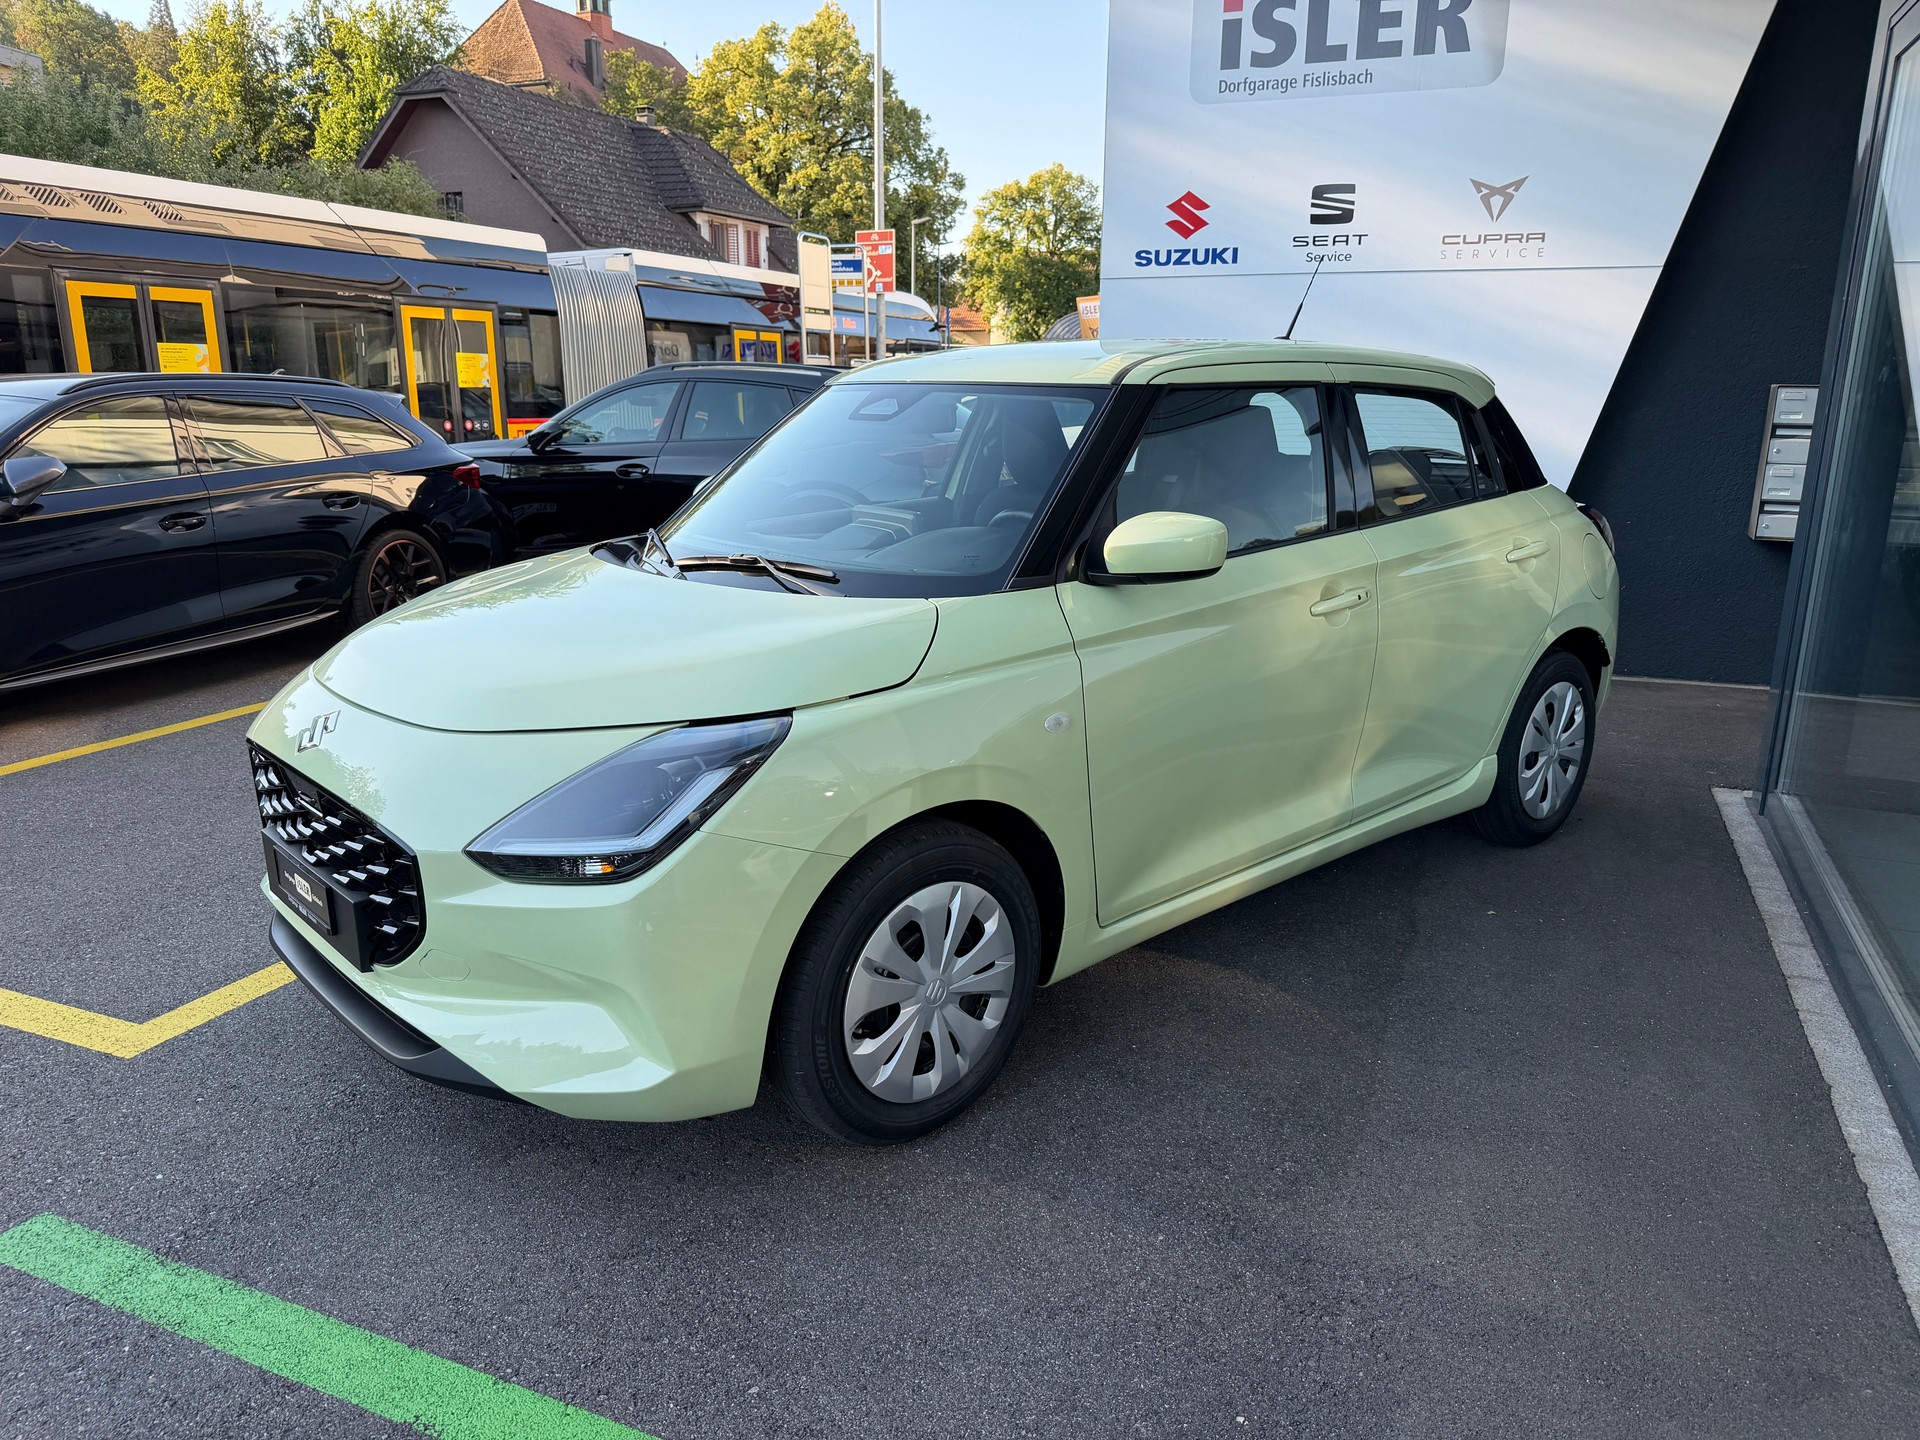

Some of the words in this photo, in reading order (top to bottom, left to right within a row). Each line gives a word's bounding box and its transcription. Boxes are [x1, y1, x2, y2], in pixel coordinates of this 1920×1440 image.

[1218, 76, 1298, 96] Dorfgarage
[1303, 68, 1374, 88] Fislisbach
[1292, 233, 1369, 248] SEAT
[1441, 232, 1546, 246] CUPRA
[1134, 247, 1239, 268] SUZUKI
[1305, 251, 1352, 263] Service
[1440, 247, 1545, 260] SERVICE
[1082, 305, 1100, 315] iSLE
